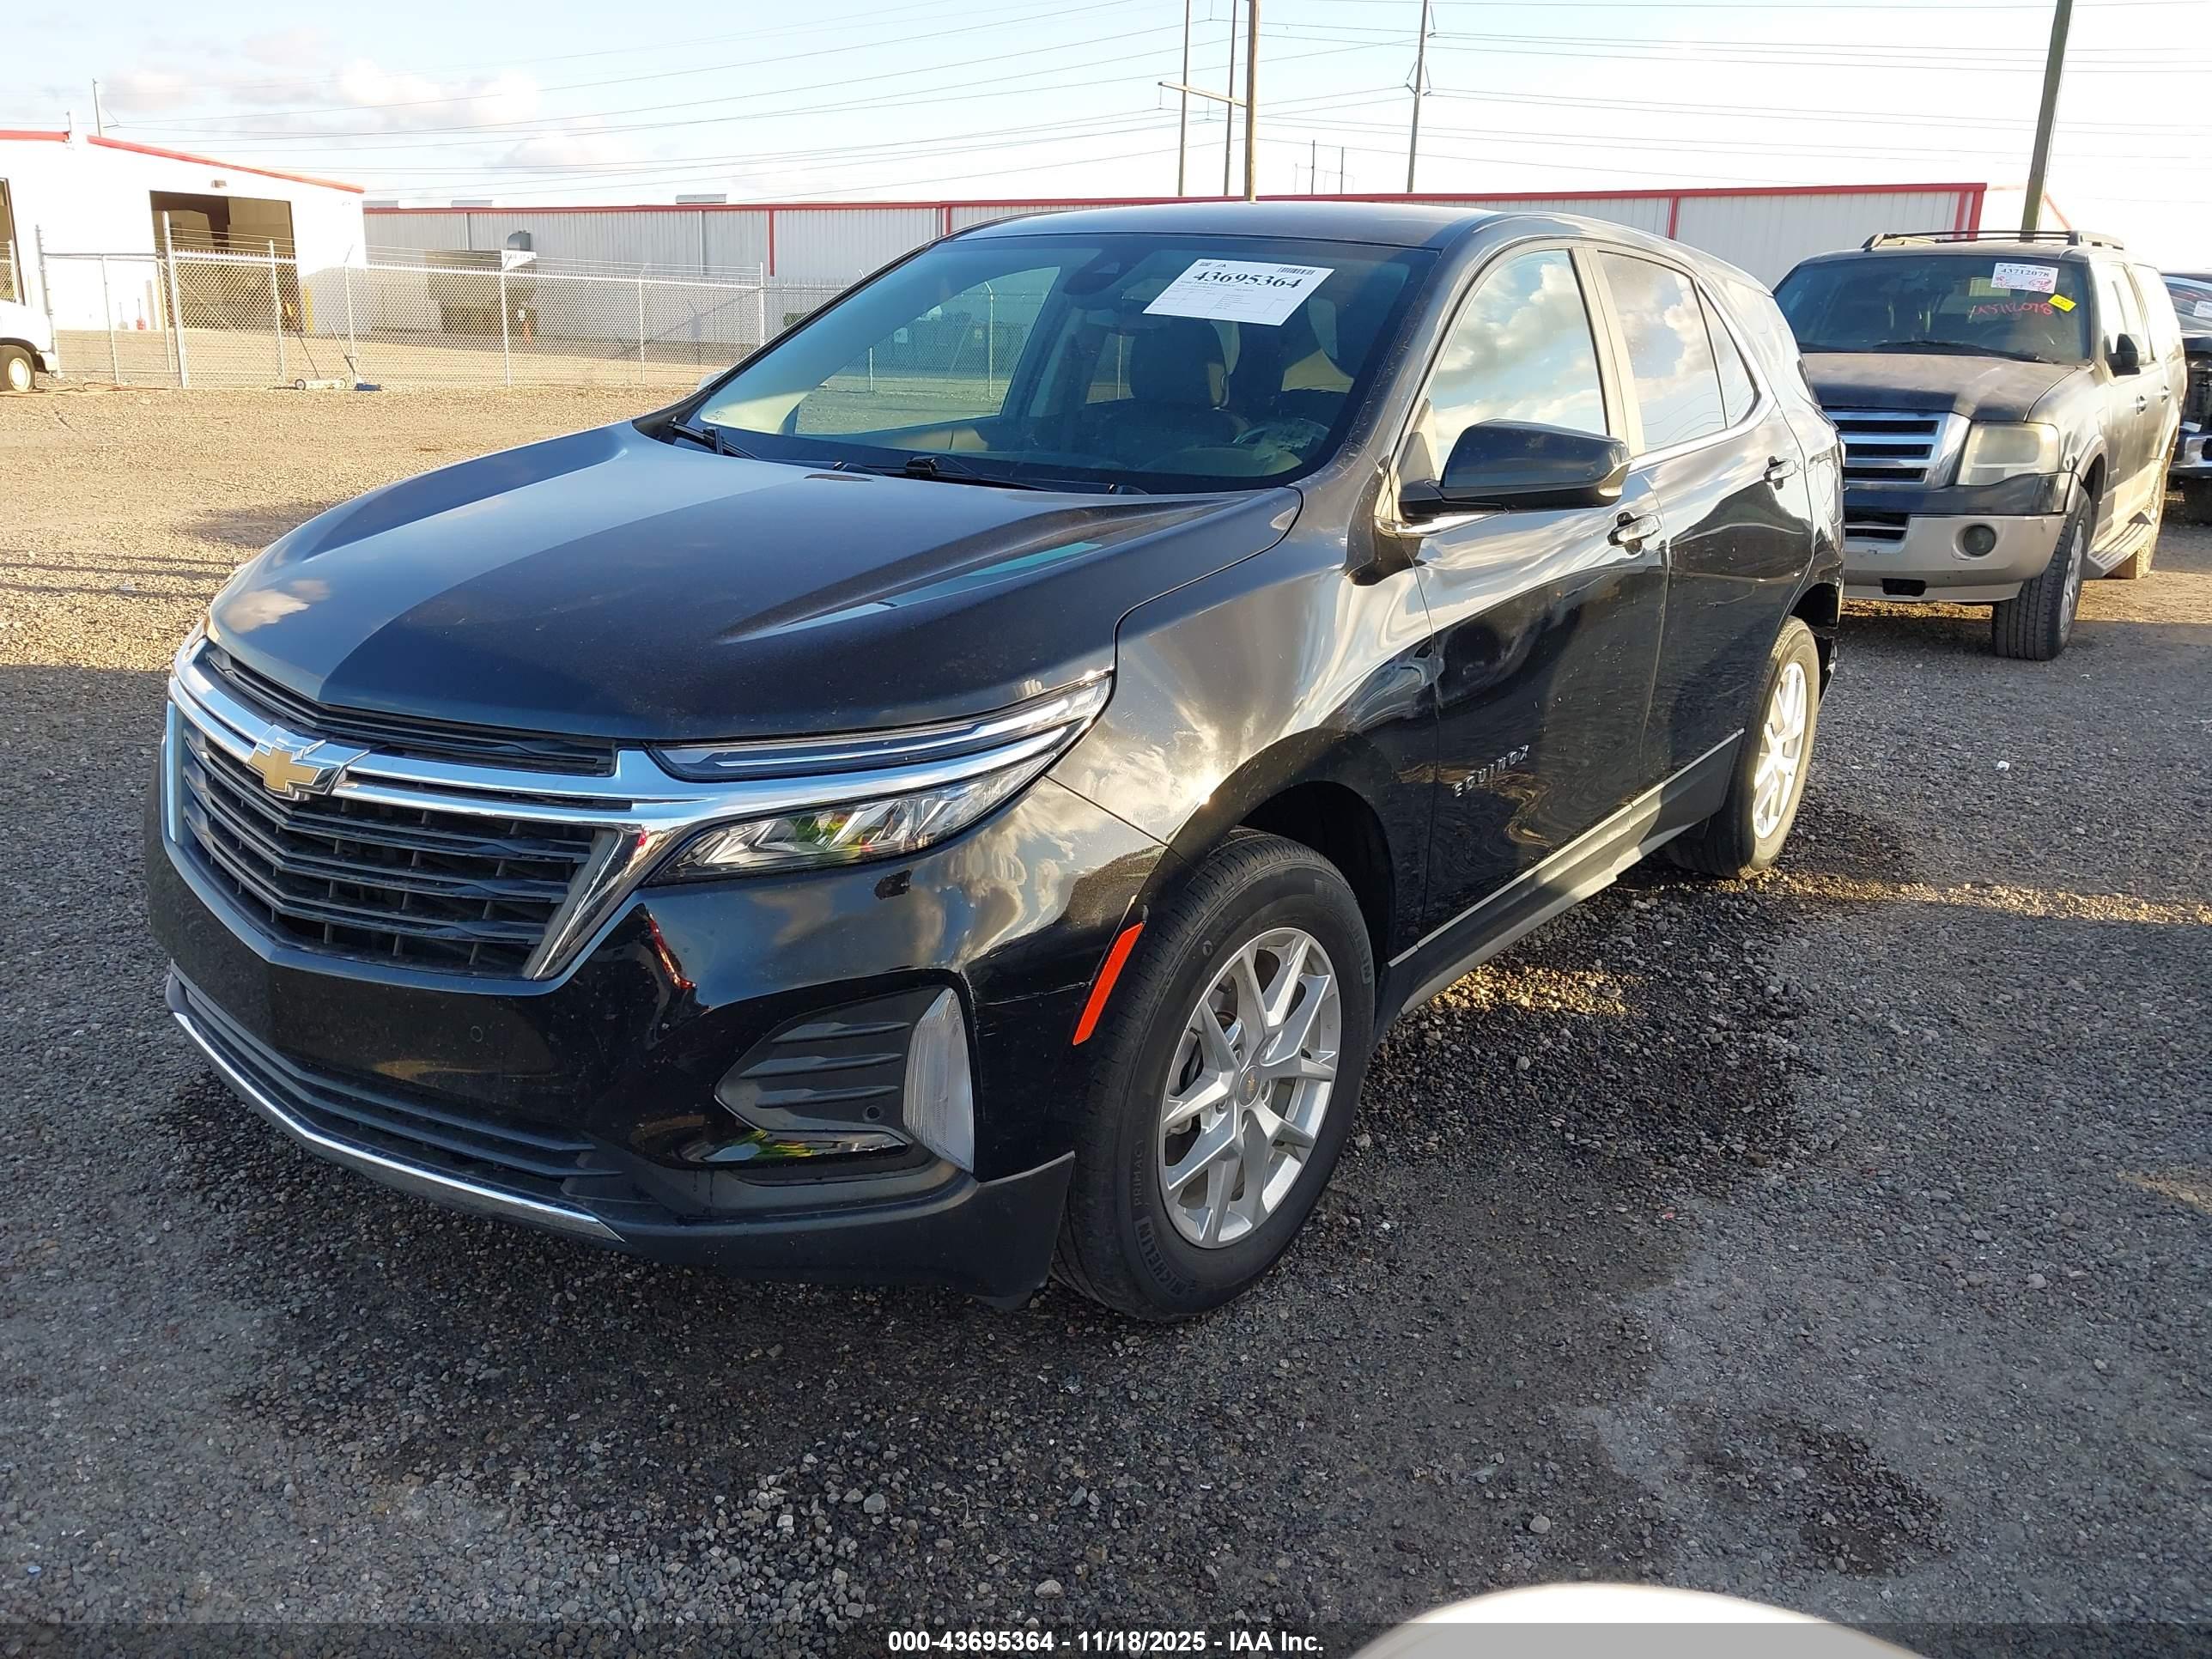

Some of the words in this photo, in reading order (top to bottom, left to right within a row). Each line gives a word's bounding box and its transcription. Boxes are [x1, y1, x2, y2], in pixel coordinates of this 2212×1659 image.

[1193, 270, 1304, 289] 43695364
[1451, 744, 1531, 798] EQUINOX
[1137, 1221, 1188, 1297] MICHELIN
